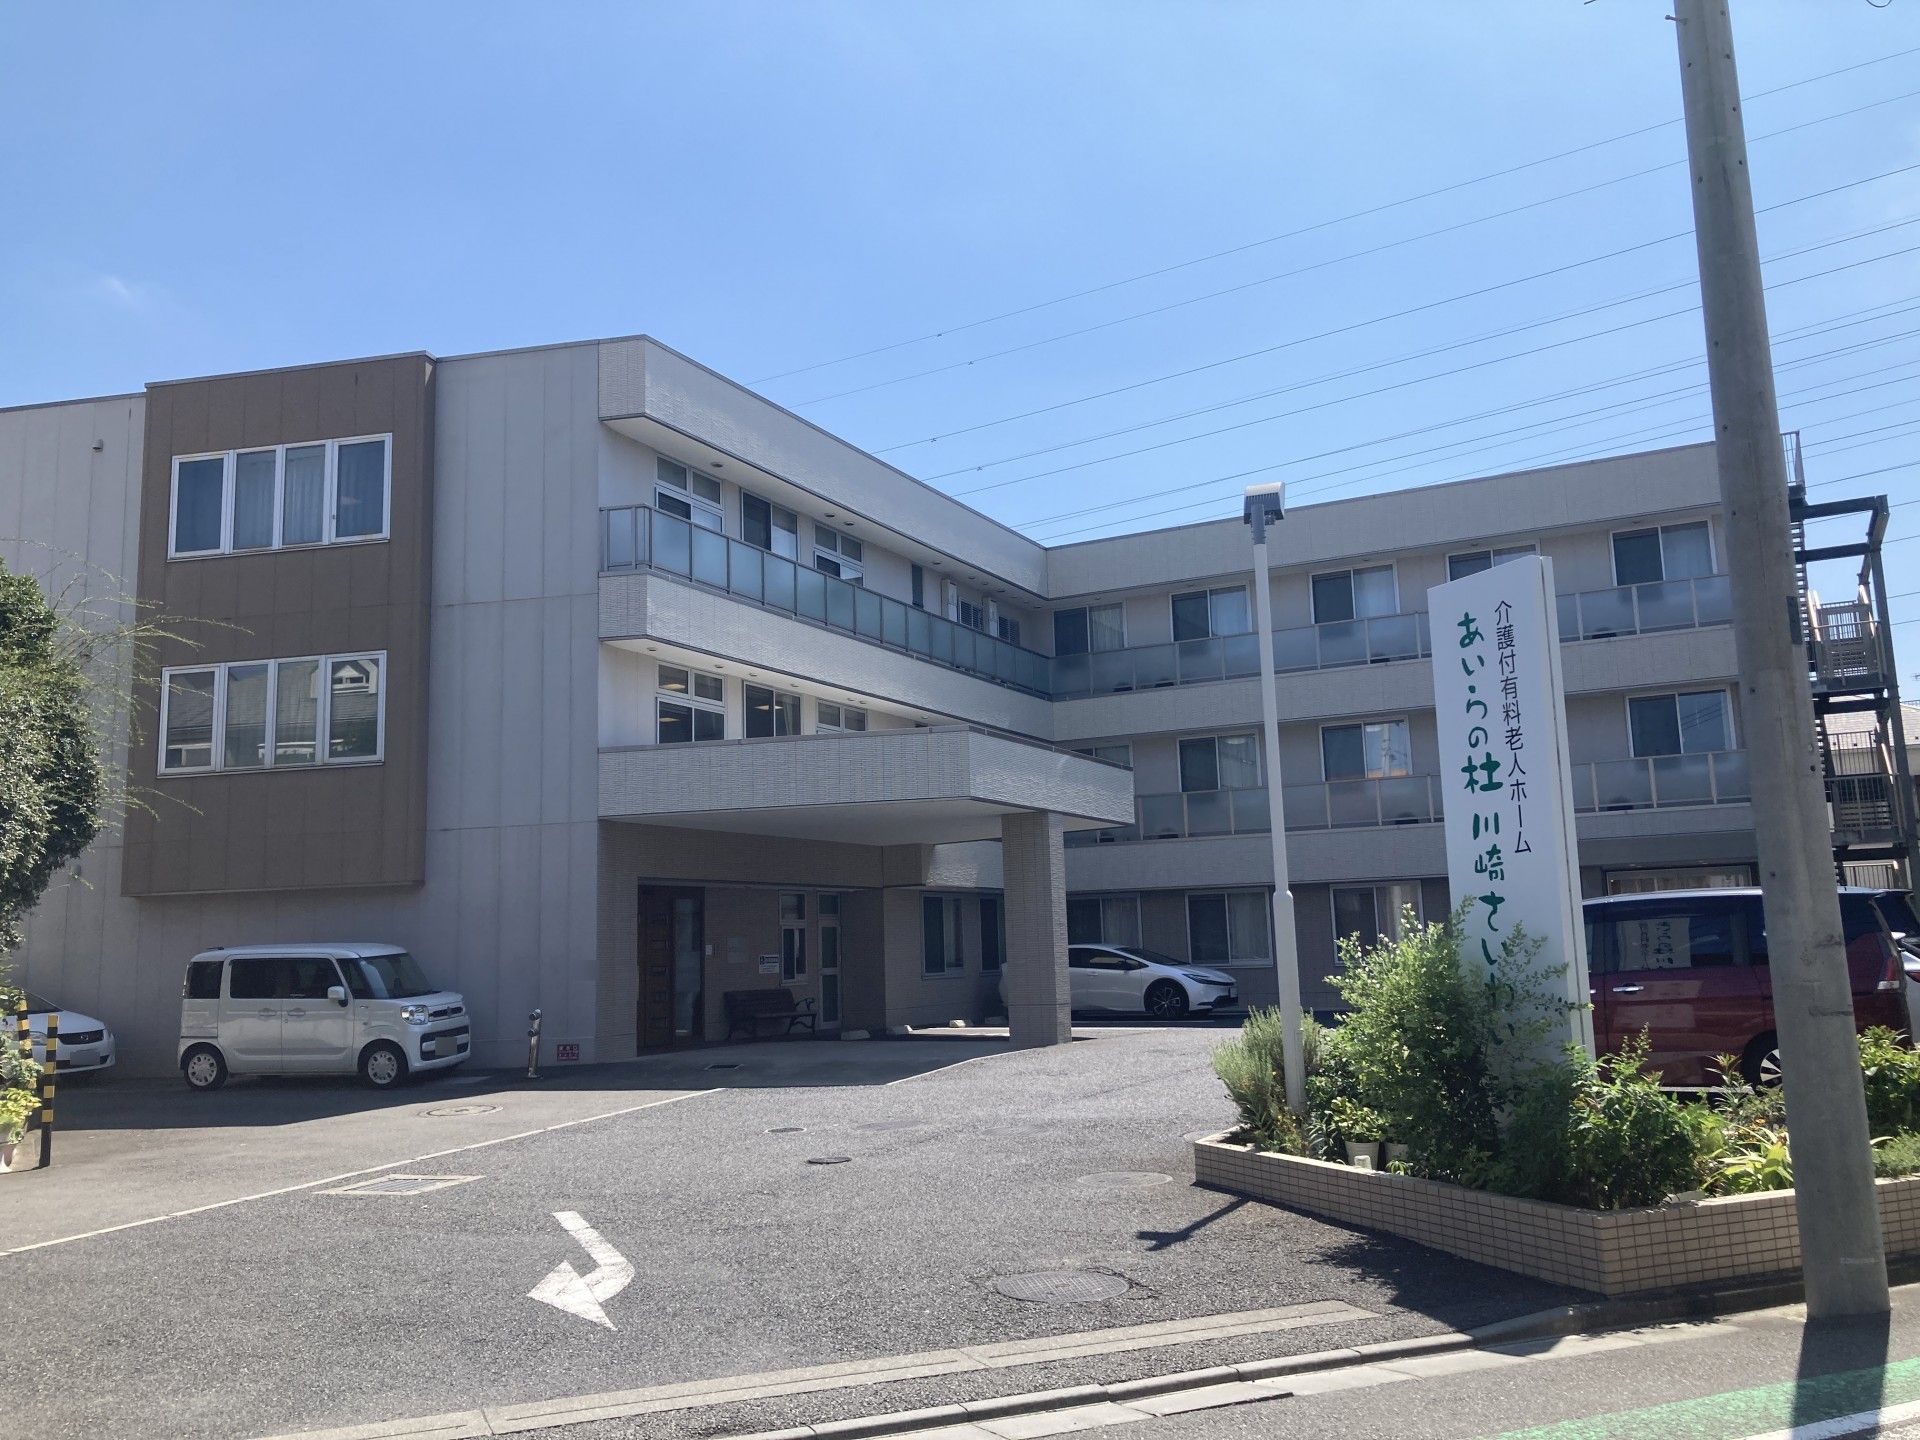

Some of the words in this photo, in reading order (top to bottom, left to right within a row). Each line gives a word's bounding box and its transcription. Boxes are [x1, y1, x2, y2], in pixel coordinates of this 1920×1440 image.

[1494, 600, 1532, 854] 介護付有料老人ホーム
